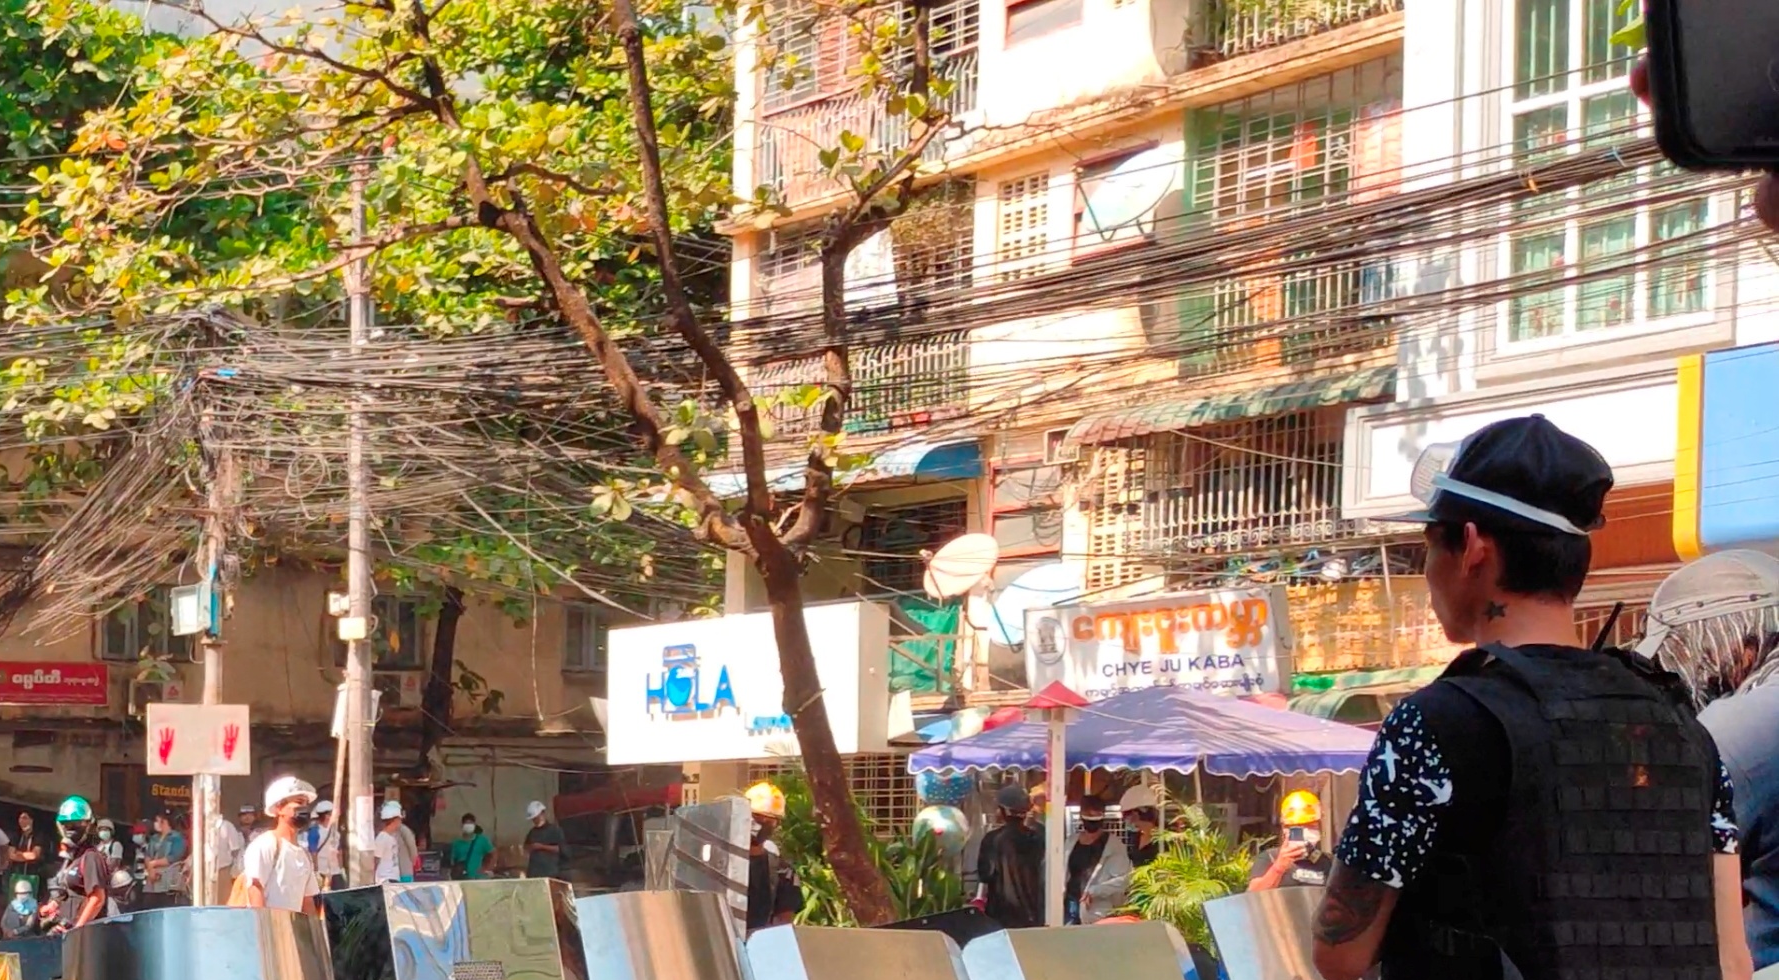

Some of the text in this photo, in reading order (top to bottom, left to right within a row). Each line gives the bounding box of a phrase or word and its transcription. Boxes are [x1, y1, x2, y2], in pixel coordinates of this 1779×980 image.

[1102, 654, 1245, 678] CHYE JU KABA
